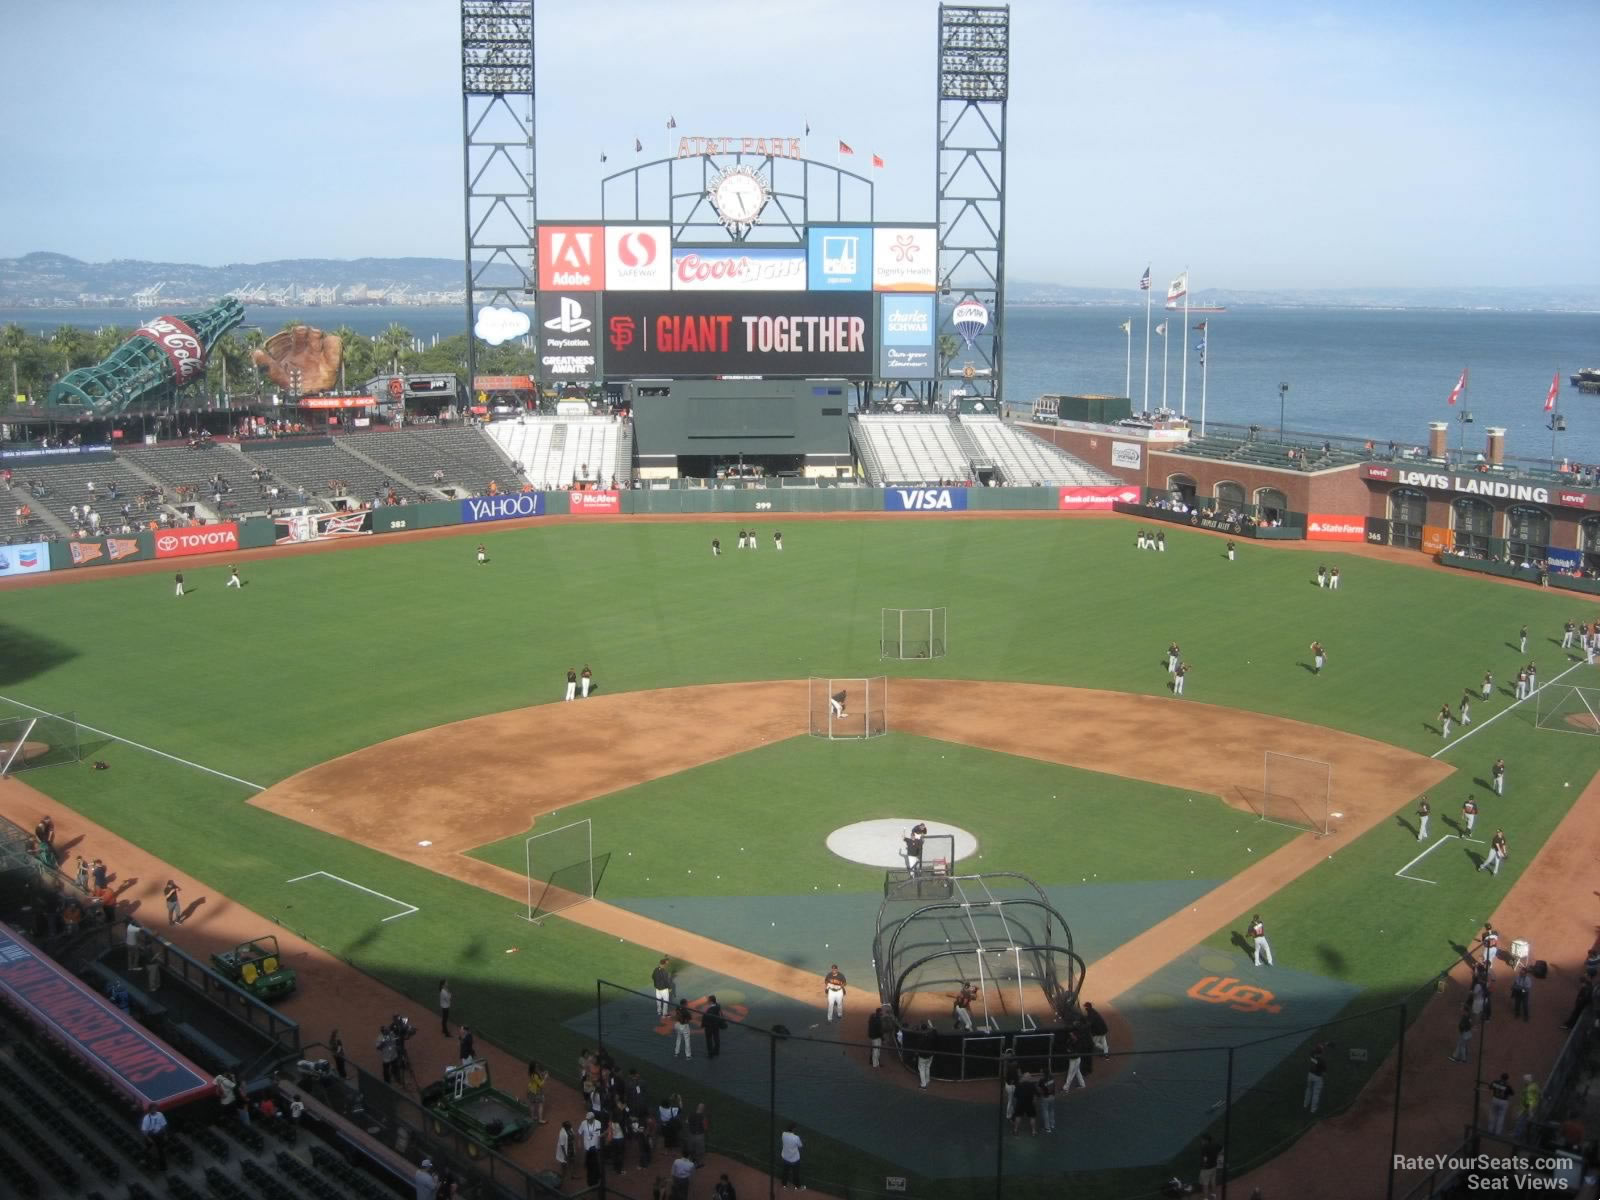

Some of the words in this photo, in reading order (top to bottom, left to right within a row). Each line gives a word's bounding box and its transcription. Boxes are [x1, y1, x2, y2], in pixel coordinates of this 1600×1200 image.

[678, 137, 733, 159] AT&T
[743, 138, 801, 160] PARK
[720, 164, 773, 202] FRANCISCO
[617, 269, 657, 277] SAFEWAY
[676, 253, 749, 283] Coors
[877, 267, 905, 277] Dignity
[906, 267, 932, 275] Health
[553, 272, 591, 286] Adobe
[887, 309, 928, 322] charles
[656, 315, 732, 352] GIANT
[741, 315, 865, 352] TOGETHER
[887, 322, 928, 332] SCHWAB
[542, 356, 595, 365] GREATNESS
[1455, 477, 1548, 503] LANDING
[583, 494, 617, 503] McAfee
[897, 490, 953, 509] VISA
[1064, 495, 1082, 503] Bank
[1082, 495, 1090, 503] of
[1089, 495, 1119, 503] America
[469, 494, 537, 521] YAHOO!
[181, 531, 236, 547] TOYOTA
[1368, 532, 1381, 541] 365
